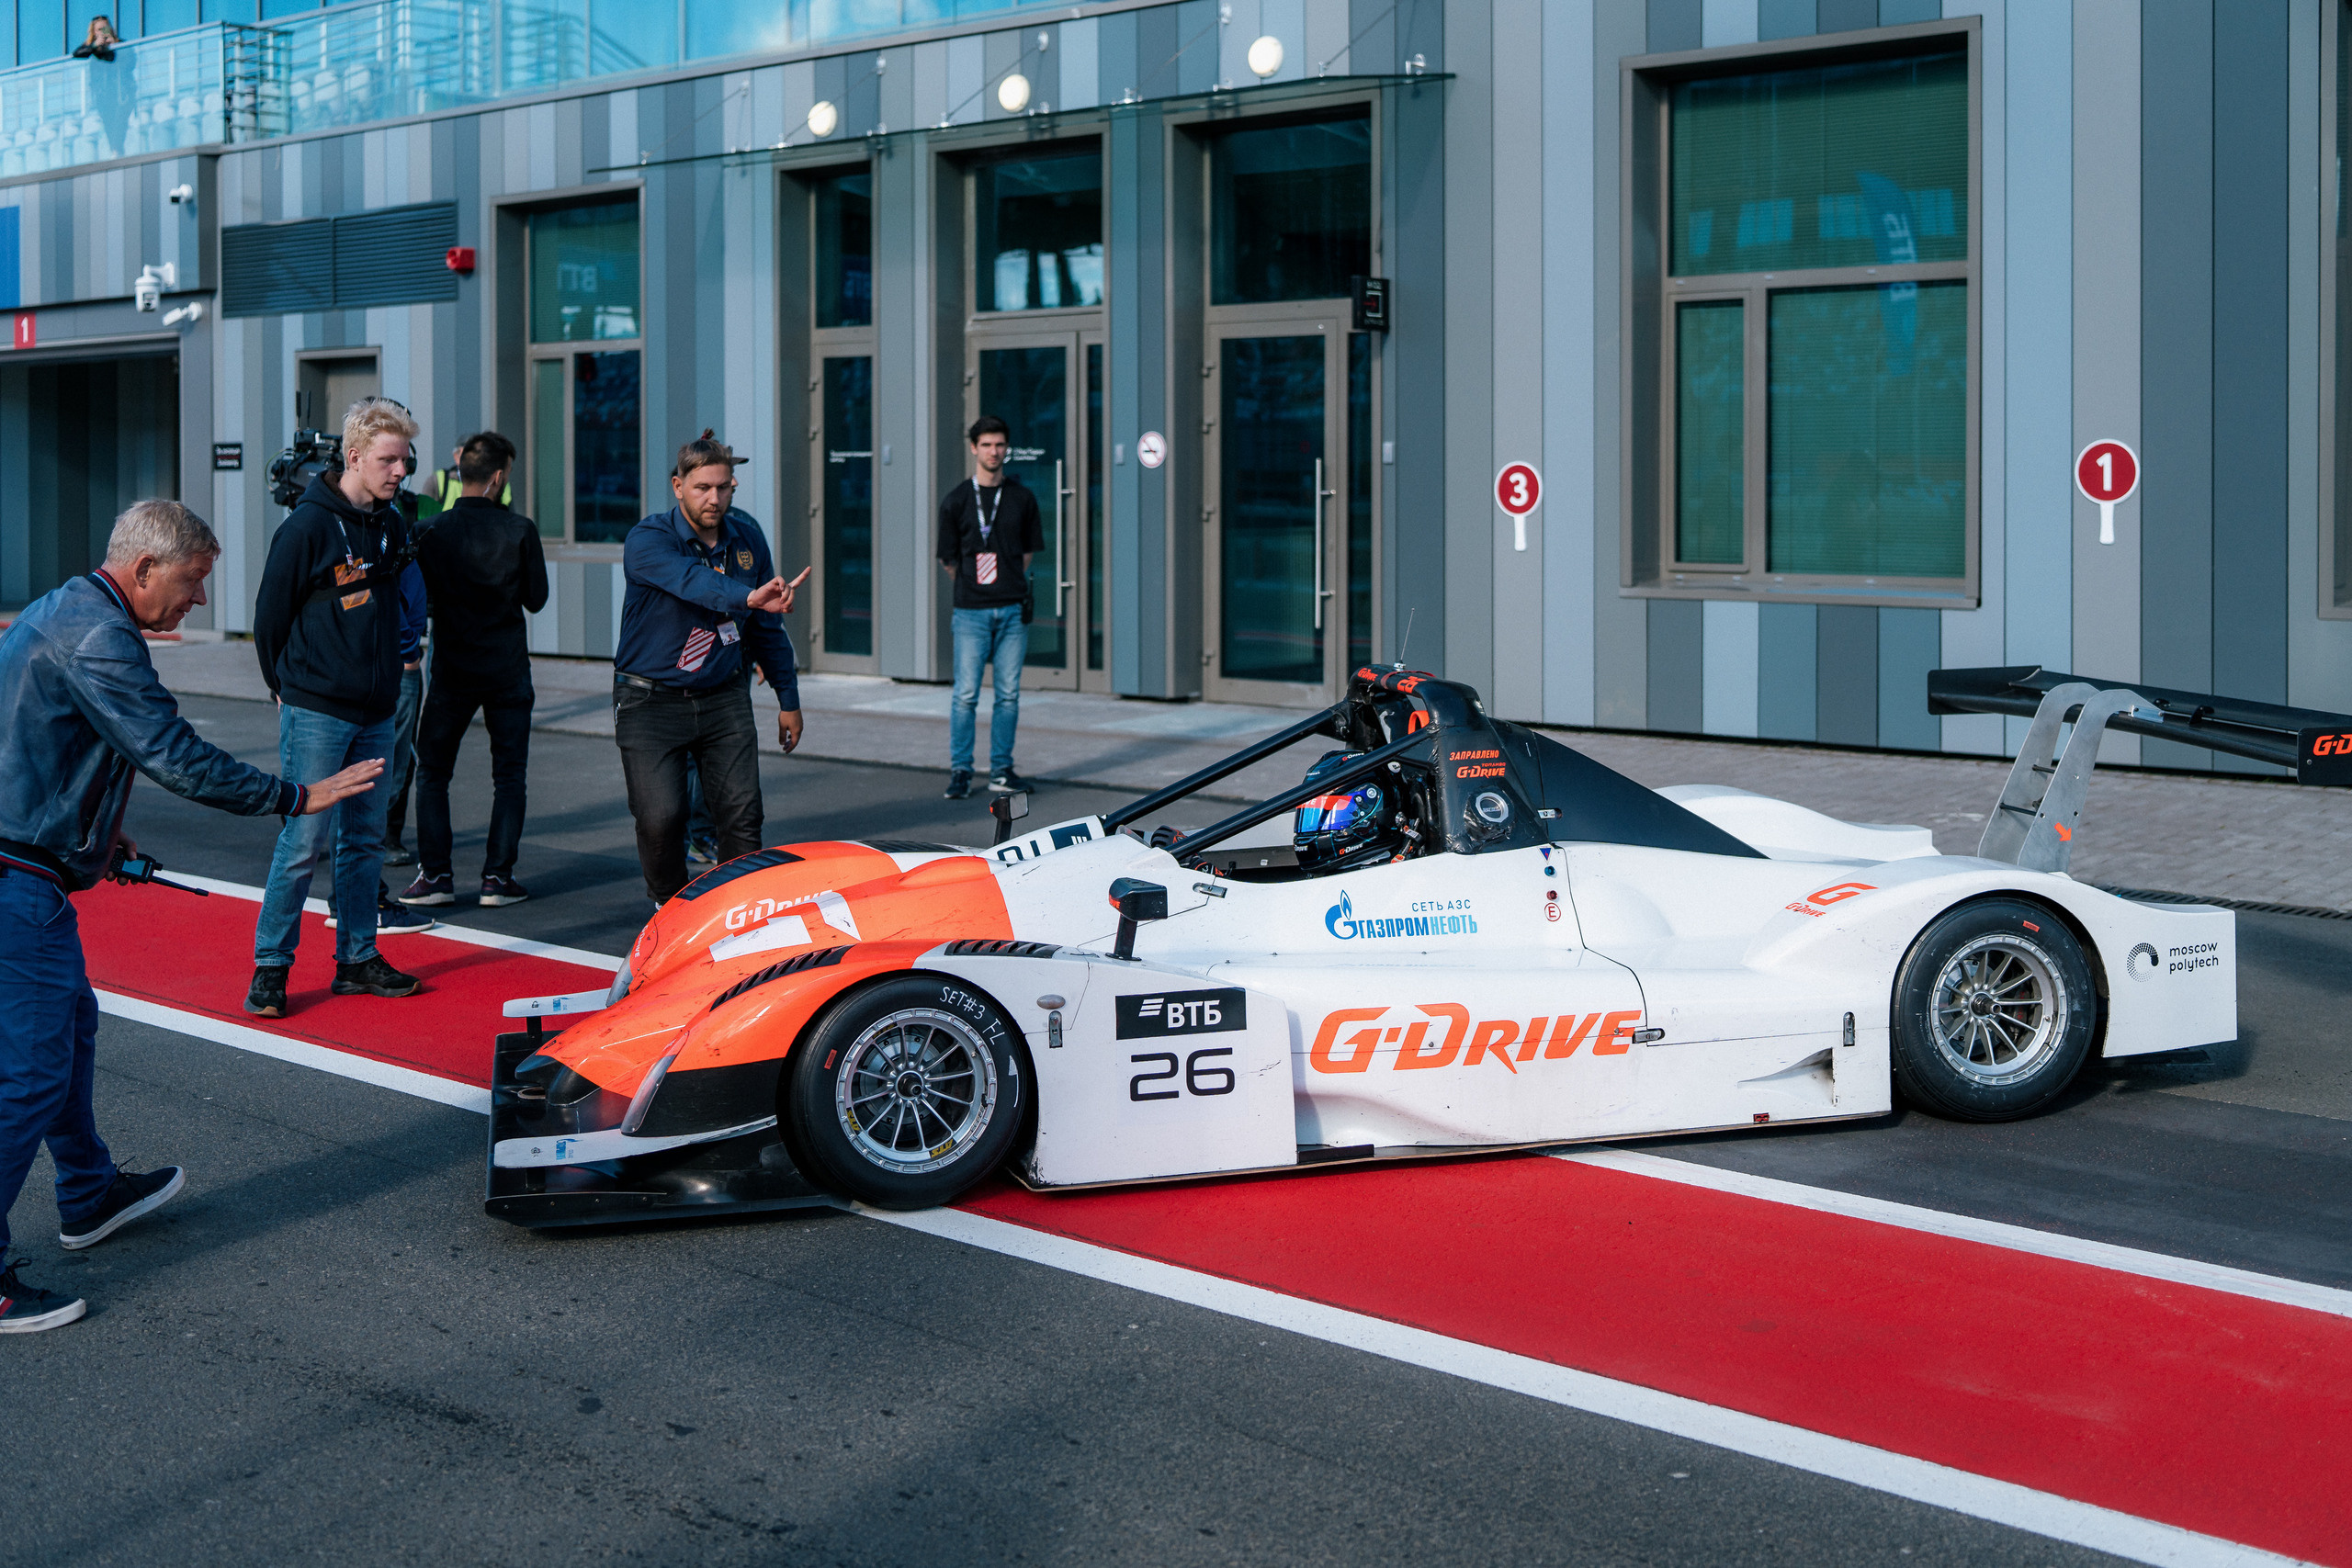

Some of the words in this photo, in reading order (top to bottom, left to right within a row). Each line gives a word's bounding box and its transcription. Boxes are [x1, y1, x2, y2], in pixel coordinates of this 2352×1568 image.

[20, 316, 28, 344] 1
[2096, 452, 2112, 491] 1
[1509, 471, 1530, 507] 3
[1449, 750, 1500, 761] ЗАПРАВЛЕНО
[1456, 765, 1506, 779] G-DRIVE
[1411, 901, 1443, 912] СЕТЬ
[1447, 899, 1472, 910] АЗС
[1547, 906, 1557, 918] E
[1357, 914, 1478, 939] ГАЗПРОМНЕФТЬ
[2169, 942, 2219, 957] moscow
[2169, 955, 2220, 975] polytech
[939, 986, 986, 1020] SET#3
[982, 1018, 1005, 1045] FL
[1167, 999, 1222, 1029] ВТБ
[1309, 1002, 1643, 1075] G-DRIVE
[1129, 1047, 1236, 1102] 26
